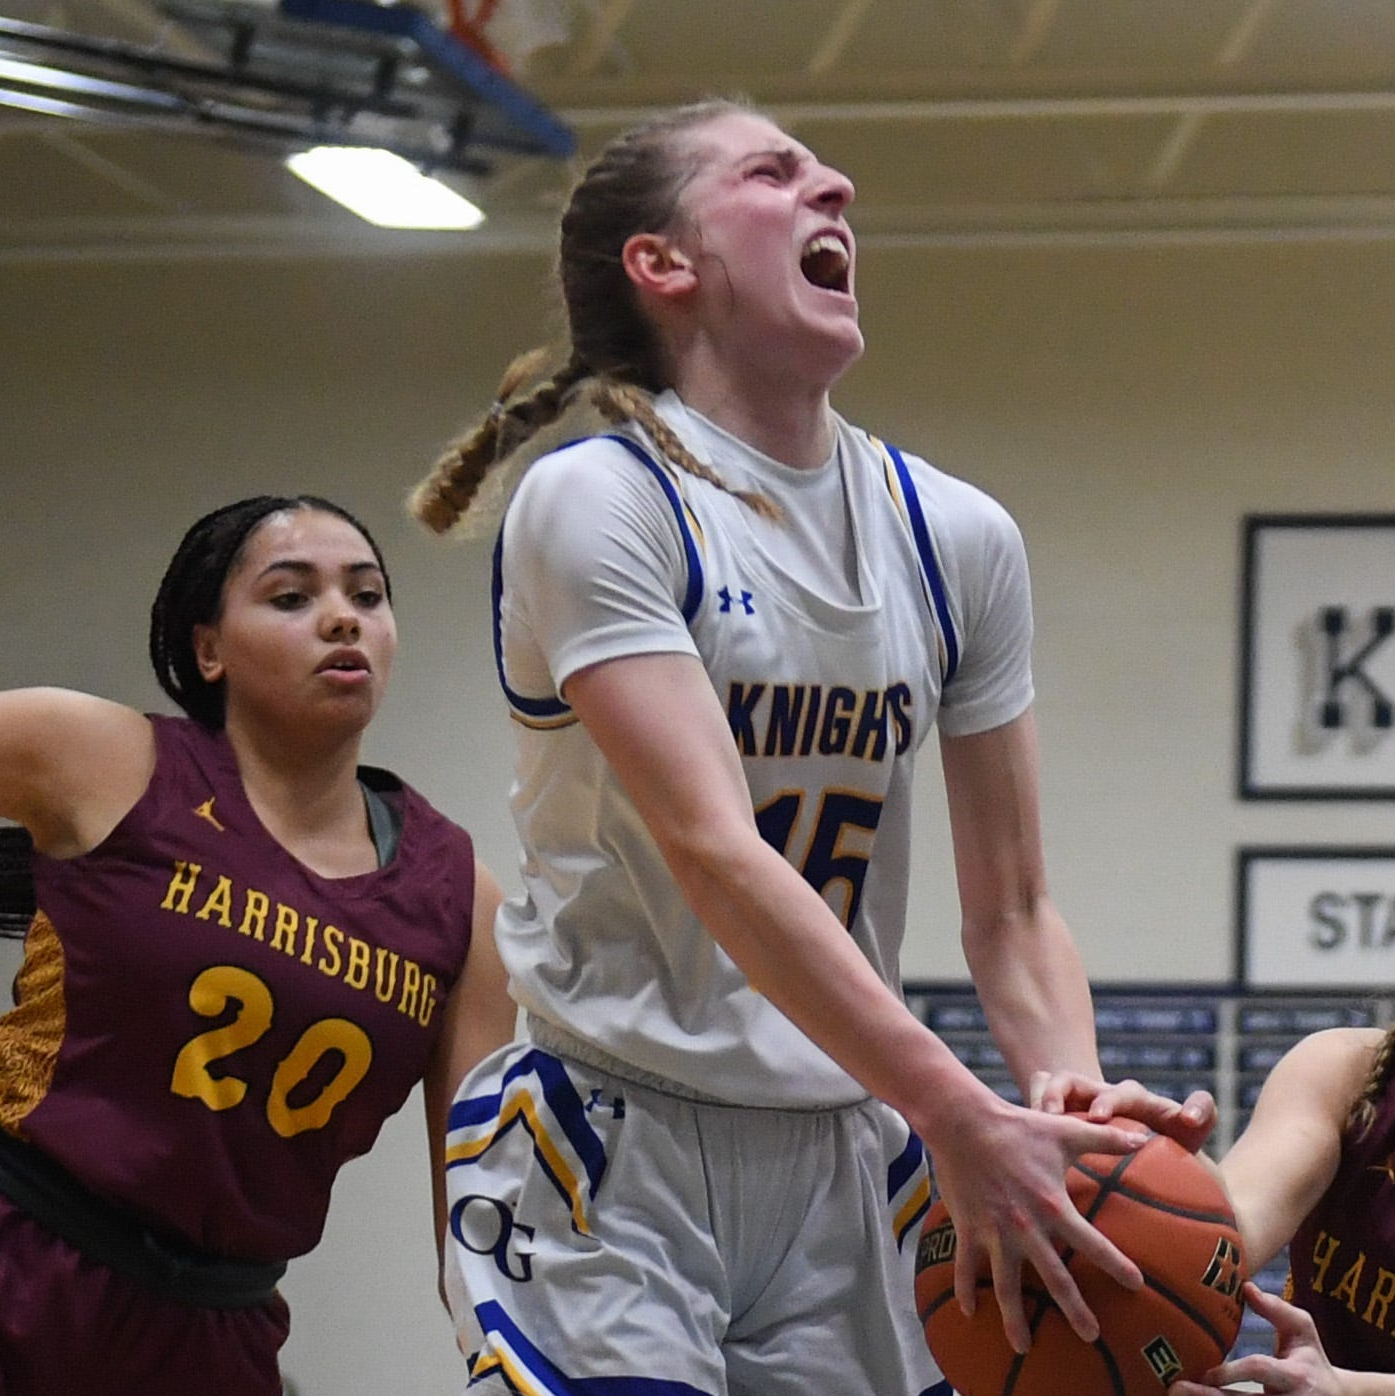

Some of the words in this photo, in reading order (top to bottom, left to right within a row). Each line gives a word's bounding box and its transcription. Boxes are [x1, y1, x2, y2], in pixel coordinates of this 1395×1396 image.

[726, 679, 912, 763] KNIGHS
[160, 860, 437, 1028] HARRISBURG
[170, 965, 372, 1138] 20
